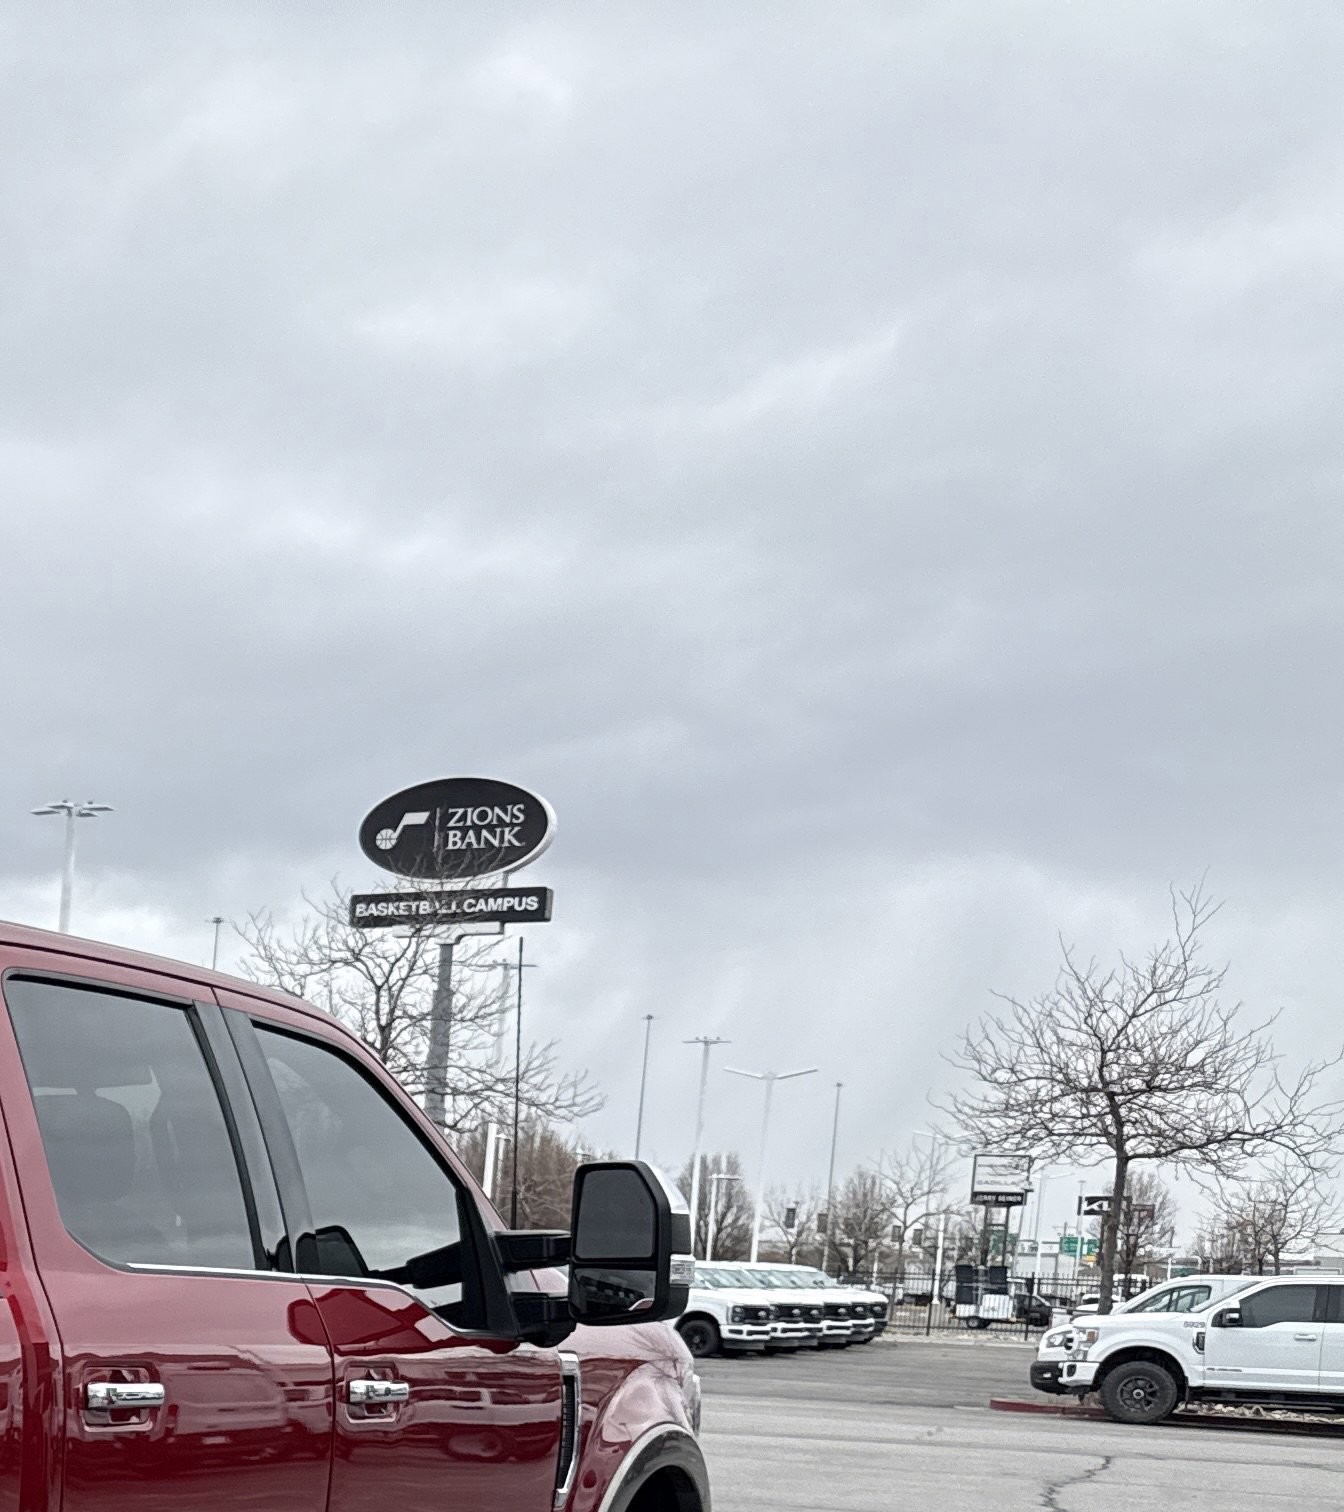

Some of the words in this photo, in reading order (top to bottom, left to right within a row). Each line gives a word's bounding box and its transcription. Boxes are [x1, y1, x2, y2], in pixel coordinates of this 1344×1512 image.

[446, 803, 525, 827] ZIONS
[445, 826, 524, 850] BANK
[461, 896, 539, 913] CAMPUS
